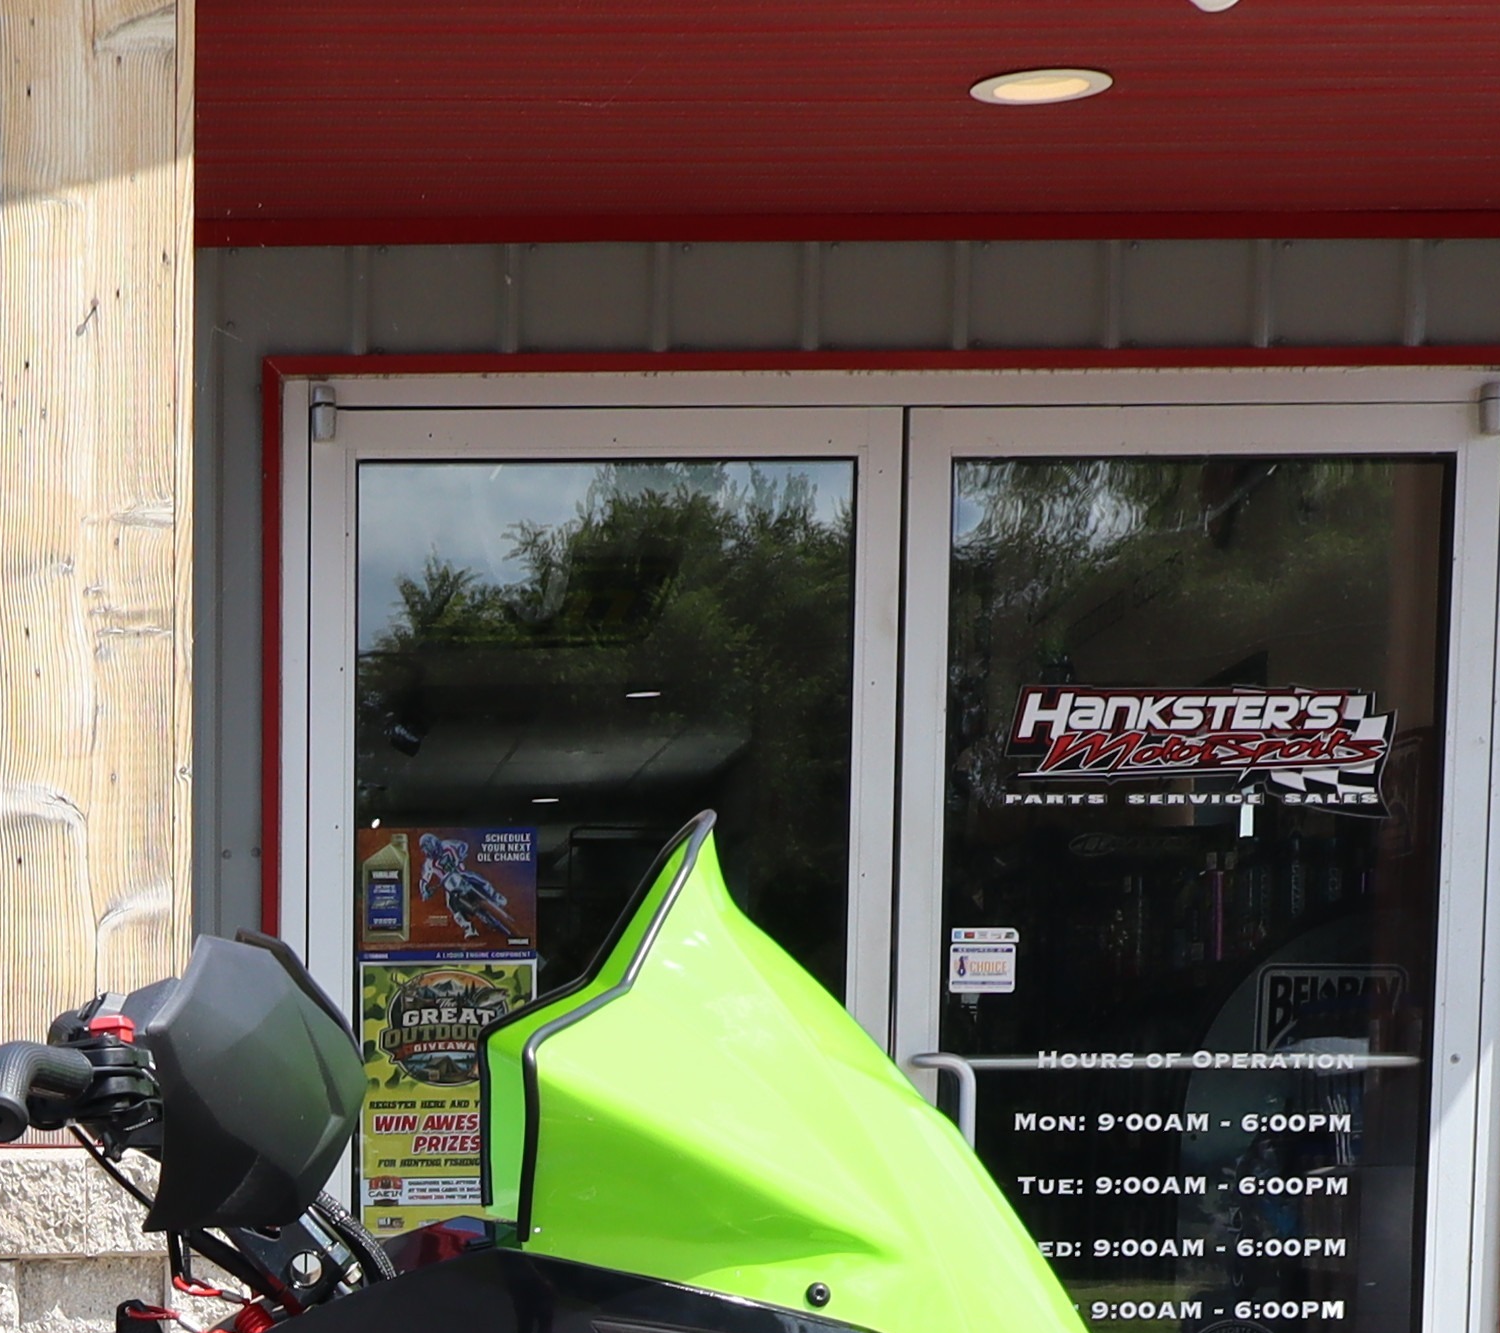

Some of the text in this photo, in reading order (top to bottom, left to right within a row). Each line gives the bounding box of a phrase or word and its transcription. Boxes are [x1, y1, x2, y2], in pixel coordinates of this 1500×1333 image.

[1005, 793, 1380, 805] PARTS SERVICE SALES
[485, 833, 531, 843] SCHEDULE
[481, 843, 531, 852] YOUR NEXT
[477, 853, 531, 862] OIL CHANGE
[969, 960, 1008, 972] CHOICE
[435, 998, 457, 1008] The
[402, 1007, 496, 1027] GREAT
[384, 1023, 480, 1048] OUTDOO
[413, 1041, 476, 1053] GIVEAWA
[369, 1101, 416, 1109] REGISTER
[420, 1100, 446, 1109] HERE
[449, 1100, 469, 1109] AND
[374, 1114, 479, 1133] WIN AWES
[1097, 1113, 1209, 1132] 9:00AM
[1241, 1113, 1351, 1132] 6:00PM
[412, 1135, 481, 1154] PRIZES
[377, 1159, 396, 1168] FOR
[1095, 1176, 1206, 1195] 9:00AM
[1239, 1176, 1348, 1195] 6:00PM
[1038, 1240, 1082, 1258] ED:
[1093, 1238, 1204, 1258] 9:00AM
[1236, 1238, 1346, 1258] 6:00PM
[1091, 1301, 1202, 1320] 9:00AM
[1234, 1301, 1345, 1320] 6:00PM
